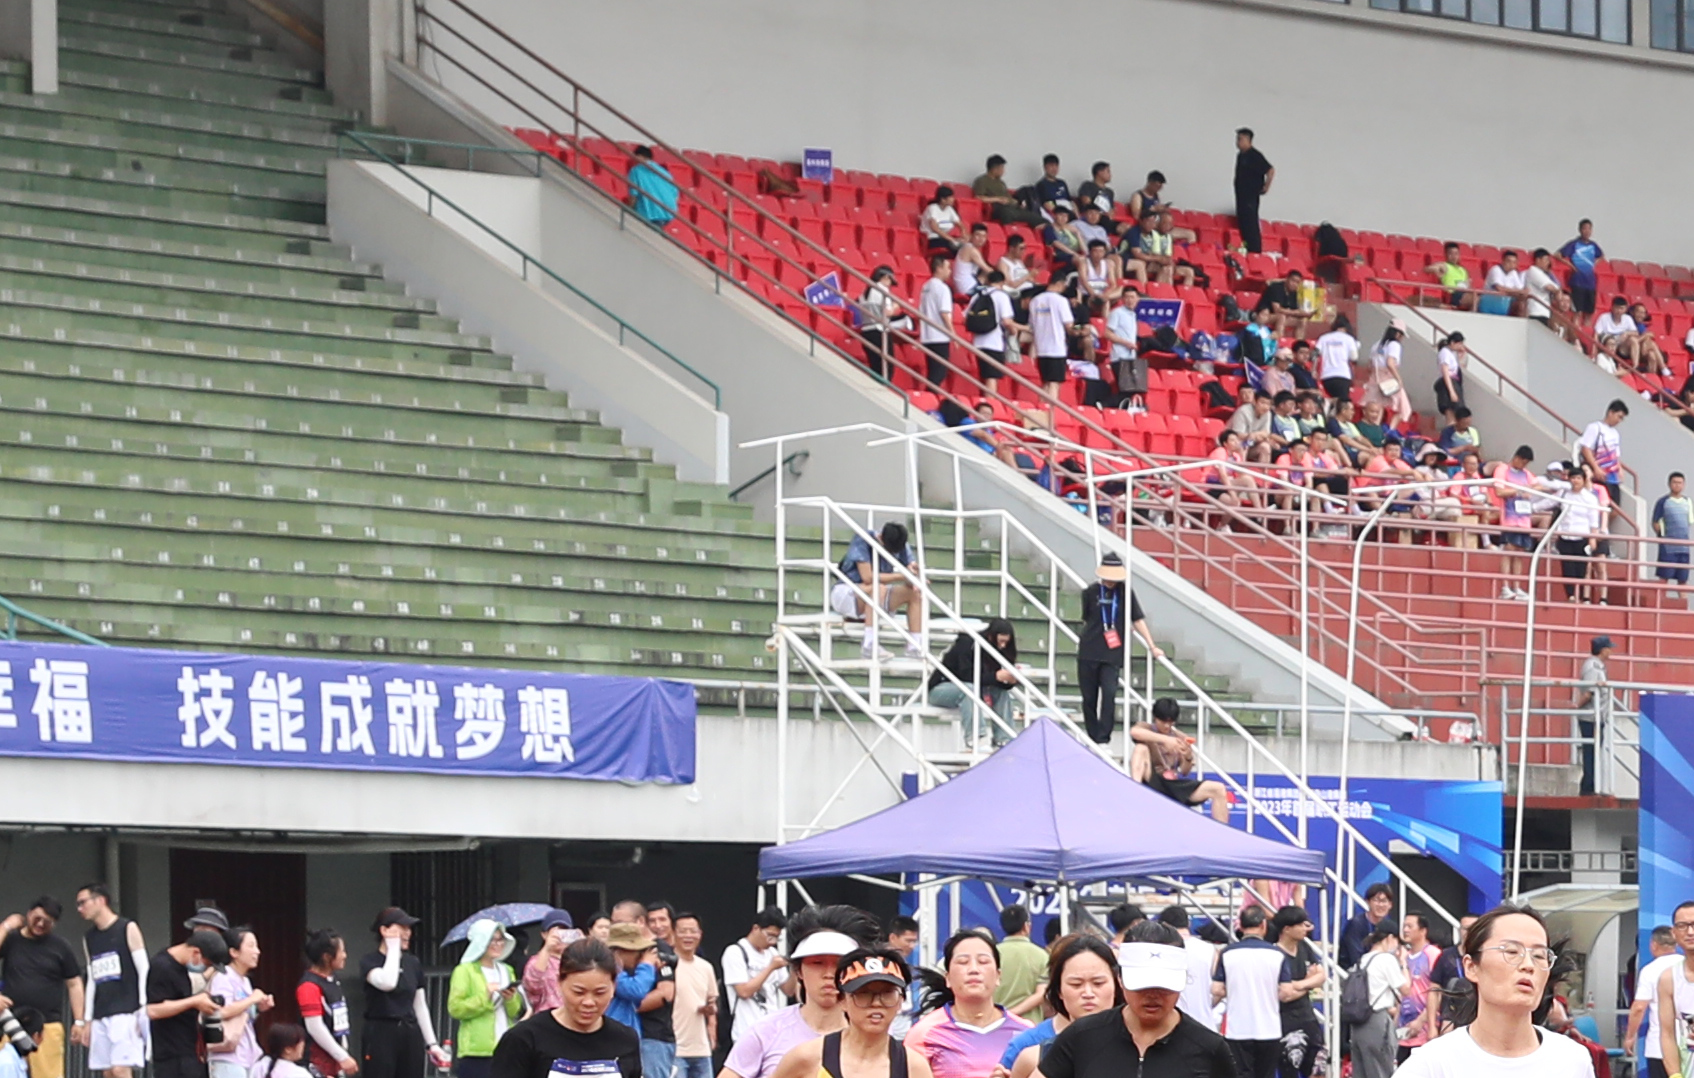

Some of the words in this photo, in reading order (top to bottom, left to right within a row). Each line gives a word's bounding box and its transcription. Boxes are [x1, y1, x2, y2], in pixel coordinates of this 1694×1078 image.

[177, 666, 575, 763] 技能成就梦想
